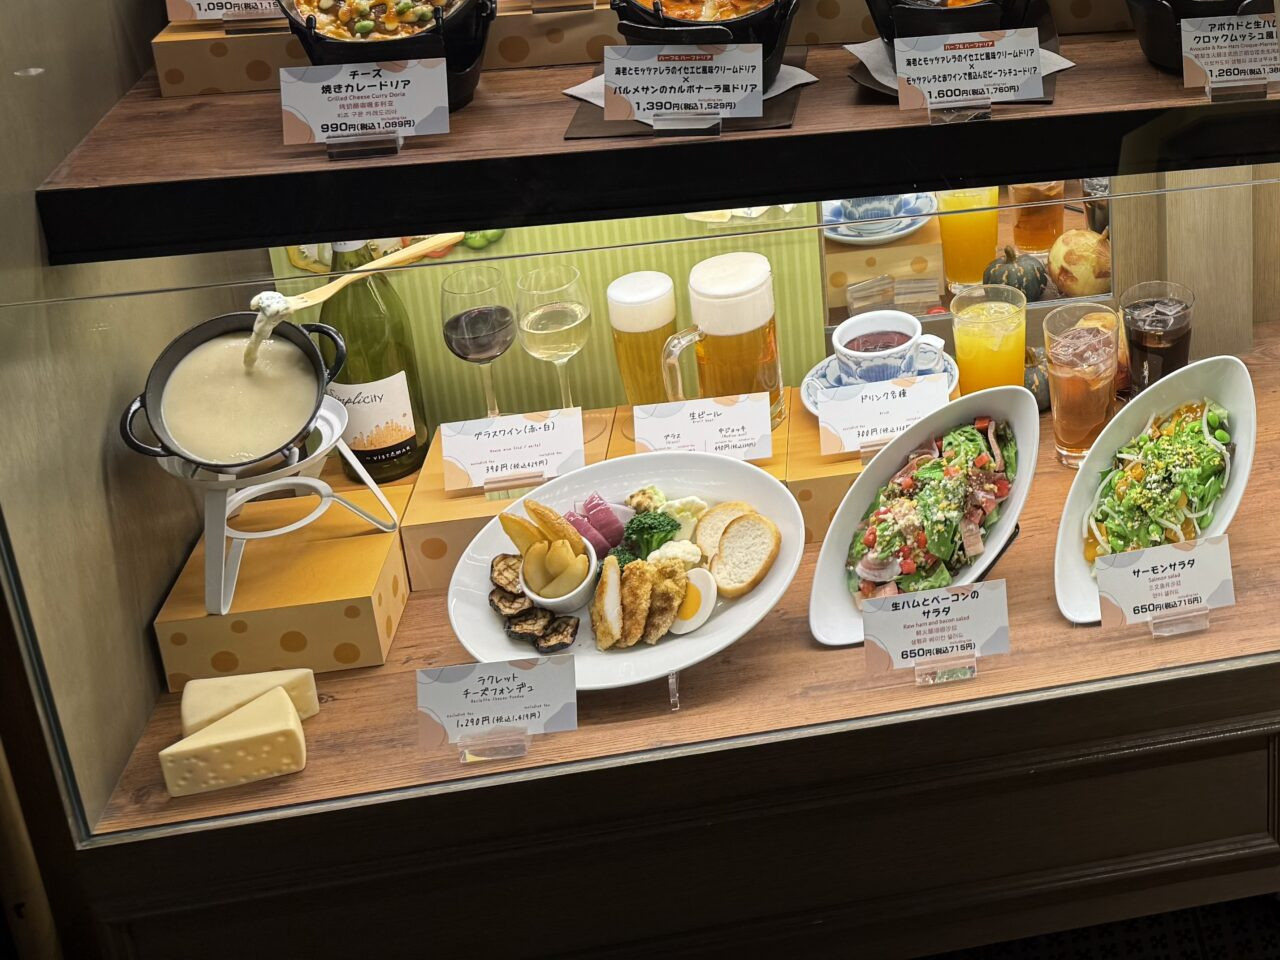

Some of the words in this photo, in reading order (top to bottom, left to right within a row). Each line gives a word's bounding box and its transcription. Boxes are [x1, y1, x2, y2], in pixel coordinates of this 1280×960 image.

[349, 68, 382, 80] チーズ
[321, 79, 411, 95] 焼きカレードリア
[371, 92, 388, 100] Curry
[635, 101, 737, 112] 1,390円(税込1,529円)
[320, 119, 416, 133] 990円(税込1,089円)
[689, 411, 722, 420] 生ビール
[1132, 559, 1195, 577] サーモンサラダ
[892, 591, 979, 611] 生ハムとベーコンの
[1133, 596, 1202, 615] 650円(税込715円)
[922, 606, 951, 618] サラダ
[901, 642, 976, 659] 650円(税込715円)
[477, 673, 518, 685] ラクレット
[462, 683, 534, 699] チーズフォンデュ
